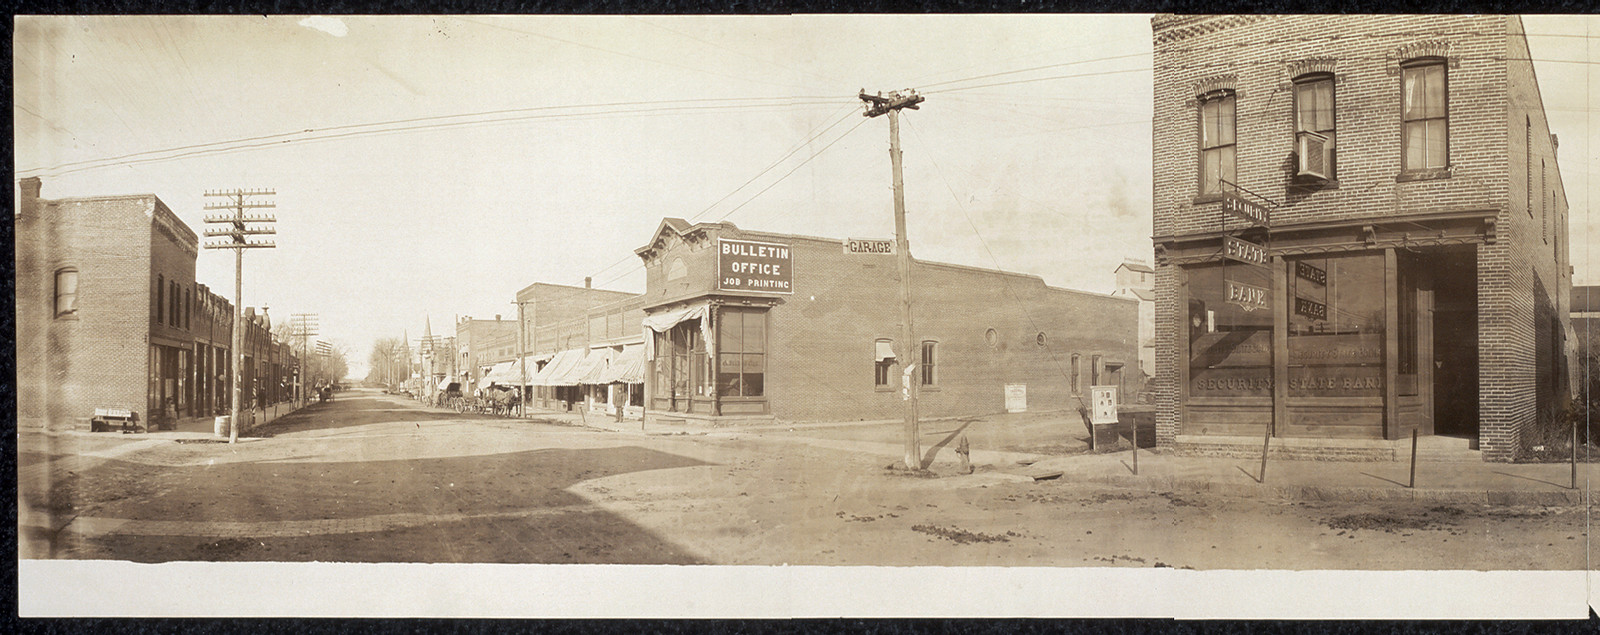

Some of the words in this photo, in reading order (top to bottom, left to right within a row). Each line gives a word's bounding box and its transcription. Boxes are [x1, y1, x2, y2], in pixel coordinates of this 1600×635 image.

[1225, 196, 1268, 223] SECURITY
[722, 243, 790, 260] BULLETIN
[850, 240, 892, 254] GARAGE
[1227, 240, 1268, 264] STATE
[731, 261, 781, 277] OFFICE
[723, 277, 741, 287] JOB
[747, 278, 790, 290] PRINTING
[1229, 283, 1265, 306] BANK
[1197, 378, 1275, 391] SECURITY
[1289, 376, 1337, 390] STATE
